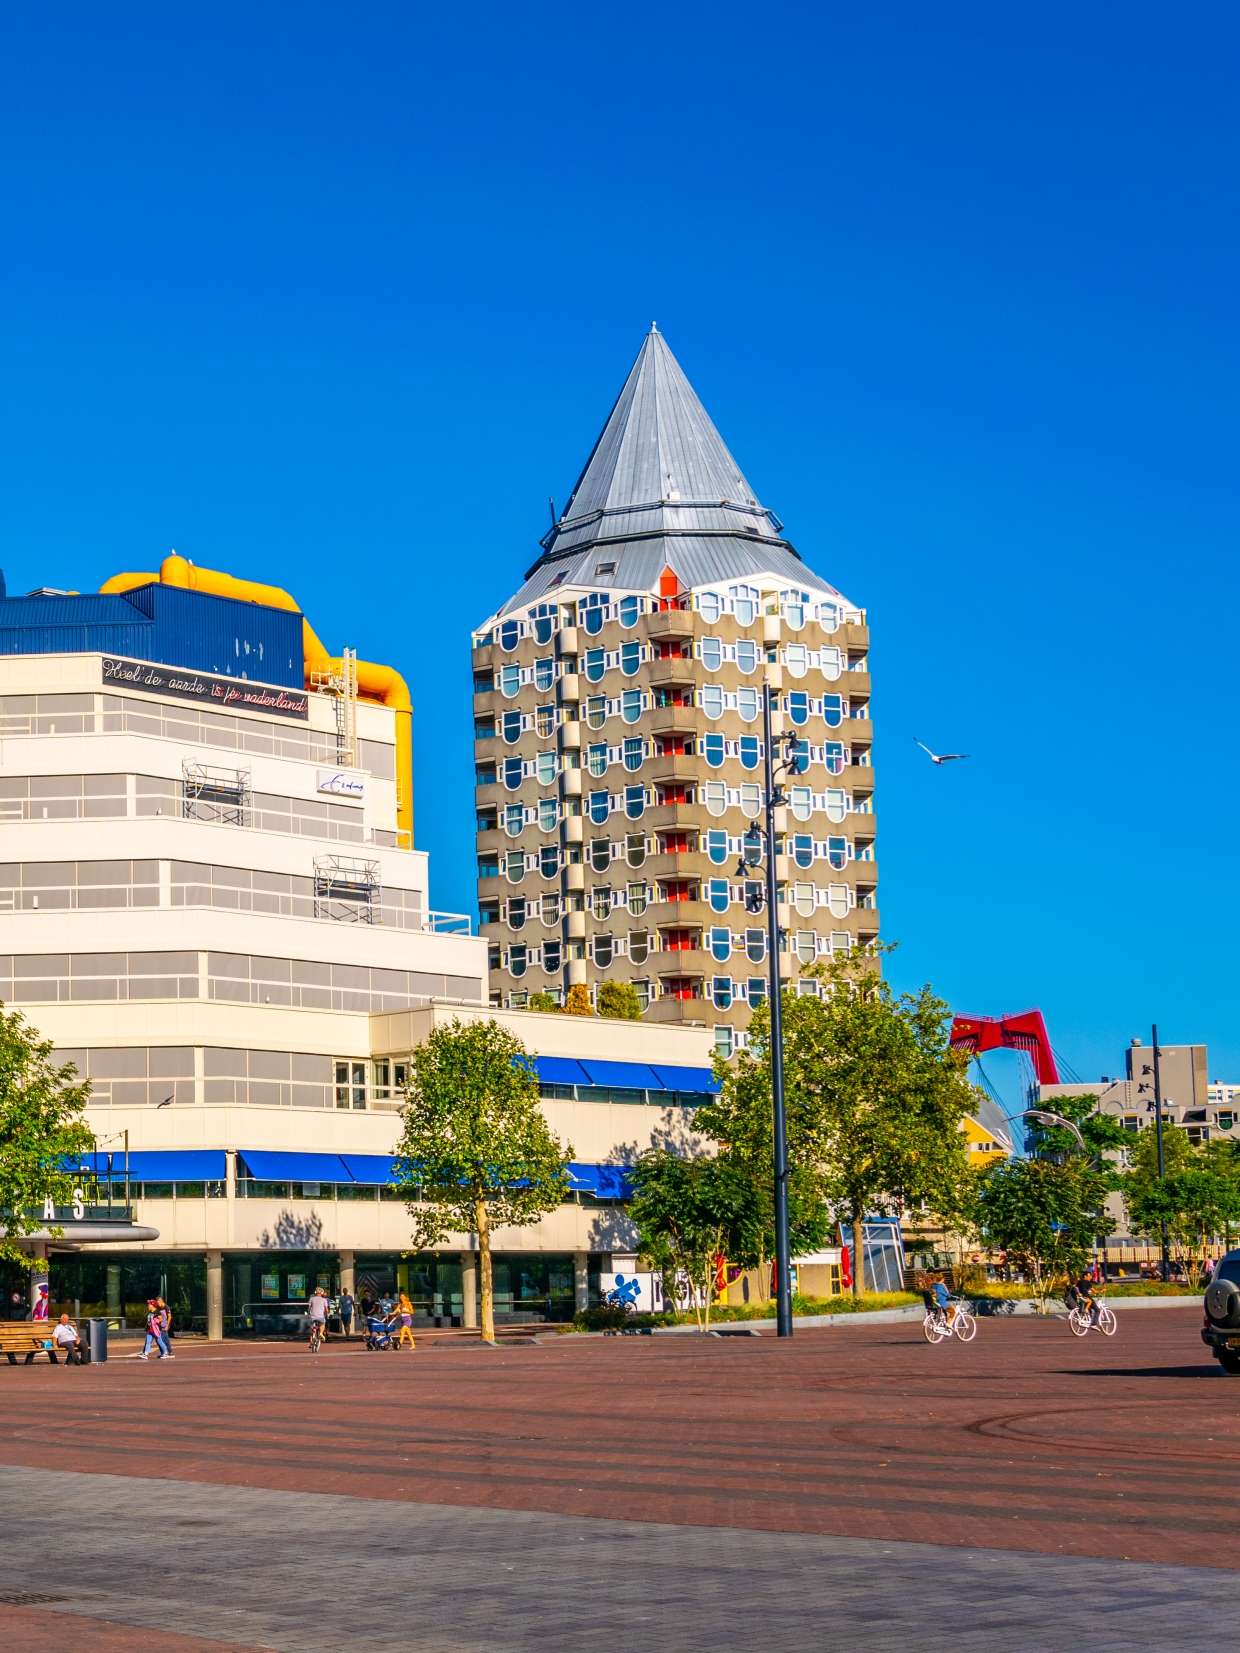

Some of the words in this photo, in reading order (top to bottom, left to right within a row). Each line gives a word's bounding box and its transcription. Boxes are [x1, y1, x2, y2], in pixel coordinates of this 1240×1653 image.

[102, 660, 141, 682] Heel
[145, 670, 163, 686] de
[168, 677, 206, 694] aarde
[211, 683, 224, 697] is
[243, 690, 308, 713] vaderland
